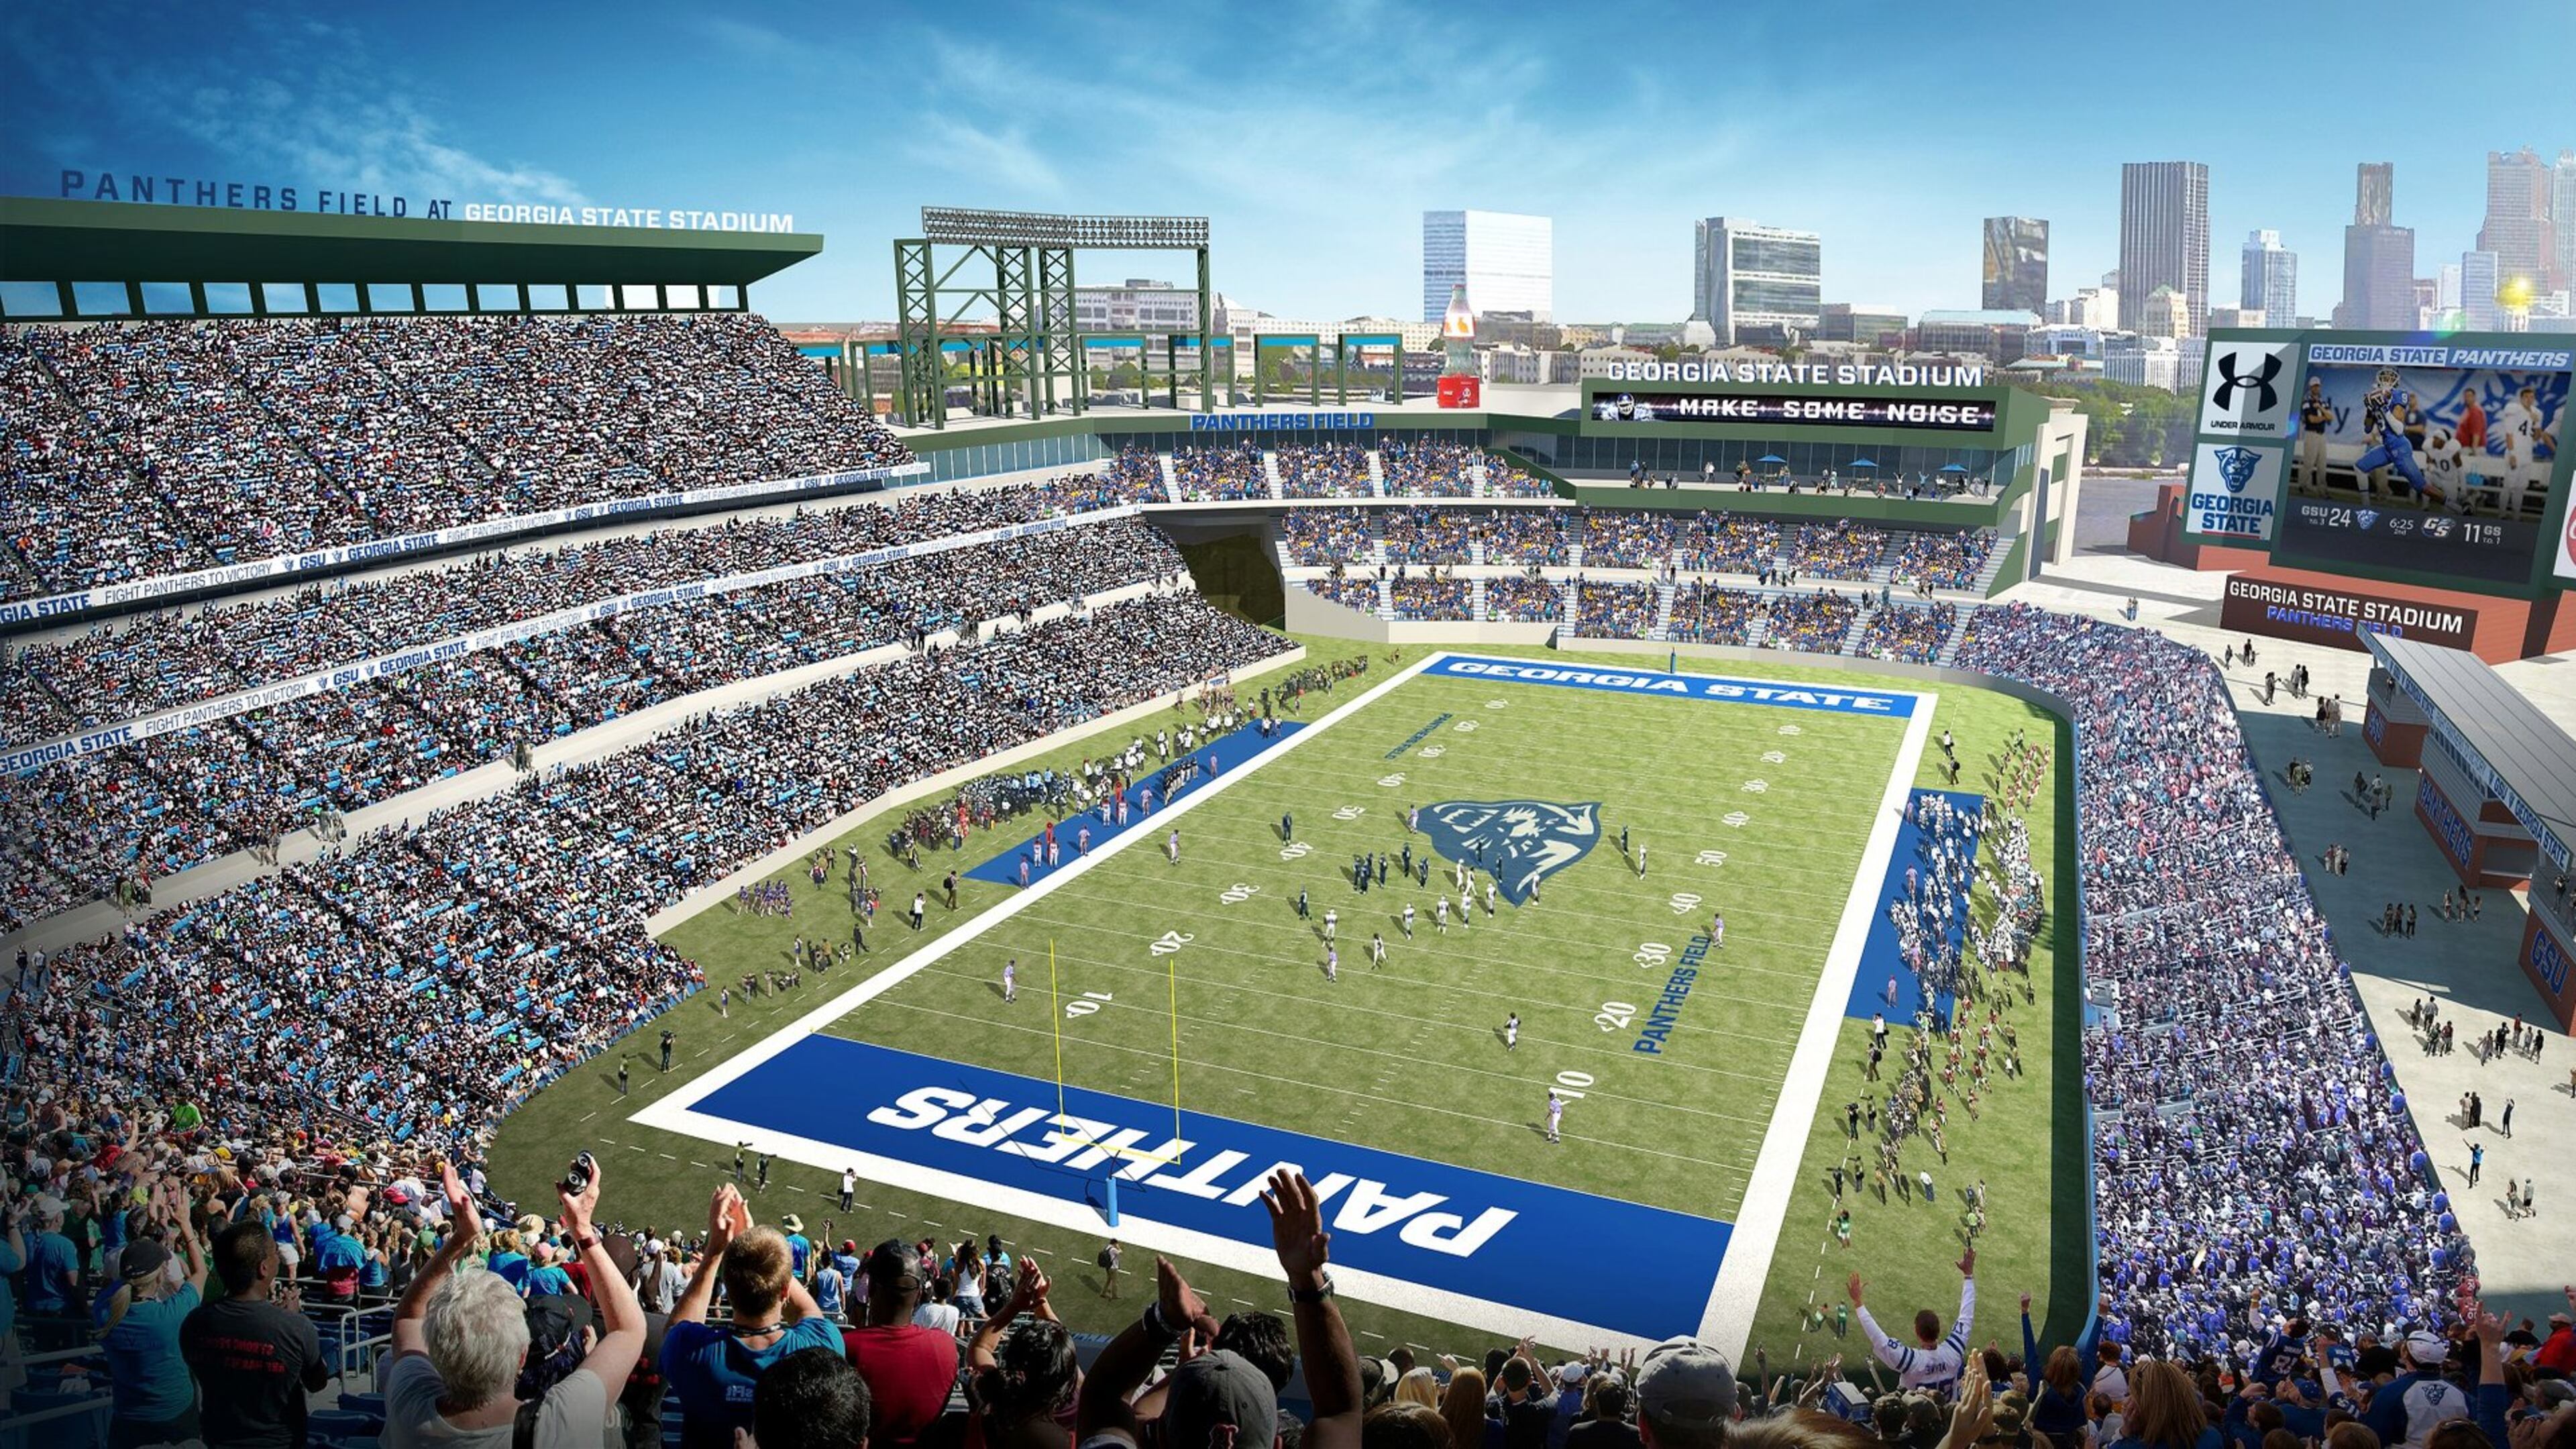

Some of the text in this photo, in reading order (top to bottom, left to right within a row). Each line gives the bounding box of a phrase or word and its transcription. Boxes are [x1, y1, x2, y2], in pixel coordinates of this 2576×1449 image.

[61, 170, 794, 233] PANTHERS FIELD AT GEORGIA STATE STADIUM
[2311, 345, 2570, 368] GEORGIA STATE PANTHERS
[1607, 362, 1984, 387] GEORGIA STATE STADIUM
[1191, 412, 1374, 430] PANTHERS FIELD
[1679, 398, 1980, 425] MAKE SOME NOISE
[2210, 420, 2275, 431] UNDER ARMOUR
[575, 508, 594, 519] GSU
[608, 498, 651, 513] GEORGIA
[654, 494, 684, 507] STATE
[2191, 492, 2273, 517] GEORGIA
[2301, 505, 2351, 527] GSU 24
[2202, 512, 2261, 534] STATE
[2389, 517, 2414, 530] 6:25
[2463, 523, 2502, 543] 11 GS
[299, 553, 326, 570] GSU
[347, 542, 401, 561] GEORGIA
[404, 533, 439, 551] STATE
[447, 529, 471, 542] FIGHT
[472, 522, 513, 538] PANTHERS
[853, 552, 886, 566] GEORGIA
[888, 547, 910, 560] STATE
[0, 562, 272, 624] GIA STATE FIGHT PANTHERS TO VICTORY
[600, 603, 617, 616] GSU
[631, 590, 674, 607] GEORGIA
[676, 584, 705, 599] STATE
[2229, 582, 2463, 634] GEORGIA STATE STADIUM
[2267, 605, 2353, 632] PANTHERS
[333, 671, 359, 686] GSU
[380, 651, 431, 673] GEORGIA
[433, 641, 468, 659] STATE
[476, 634, 498, 648] FIGHT
[500, 623, 539, 642] PANTHERS
[1447, 661, 1896, 711] GEORGIA STATE
[0, 683, 308, 773] GEORGIA STATE FIGHT PANTHERS TO VICTORY
[1332, 805, 1366, 820] 50
[2419, 775, 2474, 871] PANTHERS
[2494, 777, 2567, 867] GSU GEORGIA STATE
[1694, 849, 1727, 867] 50
[1220, 883, 1260, 902] 30
[1669, 892, 1703, 915] 40
[1149, 930, 1194, 953] 20
[1634, 942, 1672, 967] 30
[2530, 928, 2570, 997] GSU
[1065, 991, 1113, 1016] 10
[1633, 934, 1712, 1055] PANTHERS FIELD
[1594, 1001, 1637, 1030] 20
[1548, 1071, 1595, 1099] 10
[866, 1087, 1520, 1258] PANTHERS
